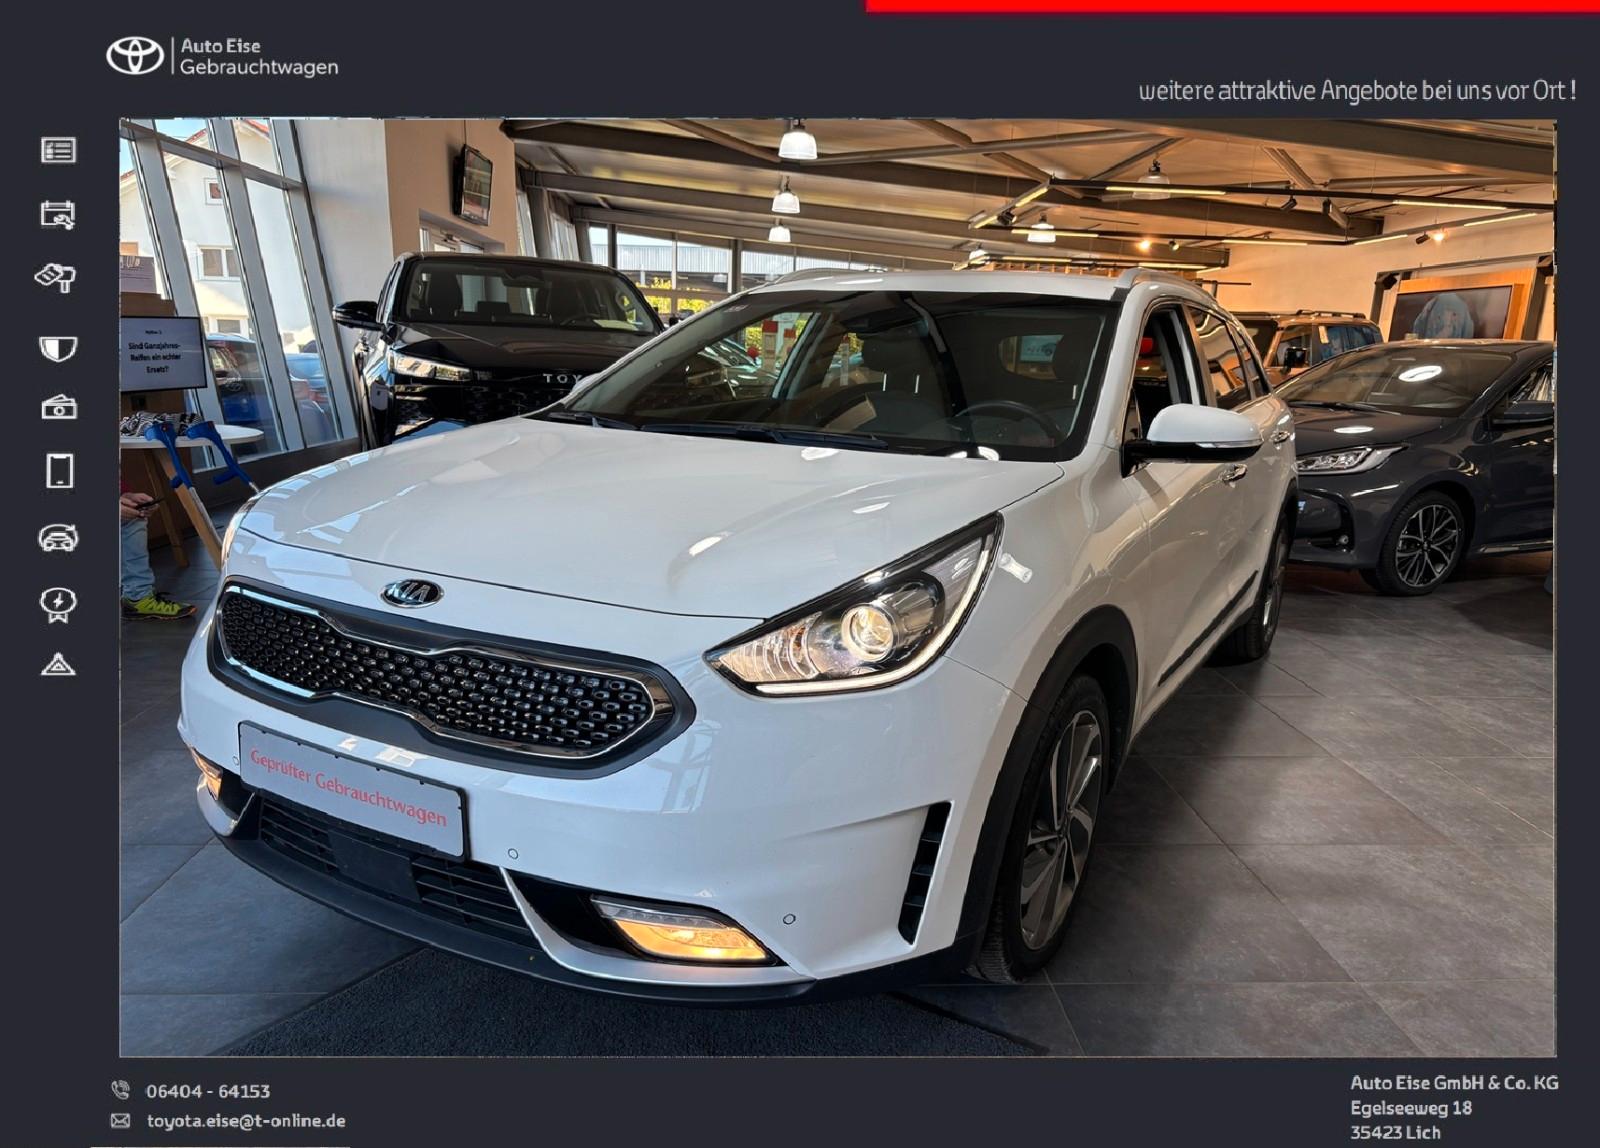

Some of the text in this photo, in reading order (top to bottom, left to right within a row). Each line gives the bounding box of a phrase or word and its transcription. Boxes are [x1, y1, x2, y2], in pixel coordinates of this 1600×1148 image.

[386, 582, 431, 603] KIA
[250, 748, 448, 828] Geprüfter Gebrauchtwagen
